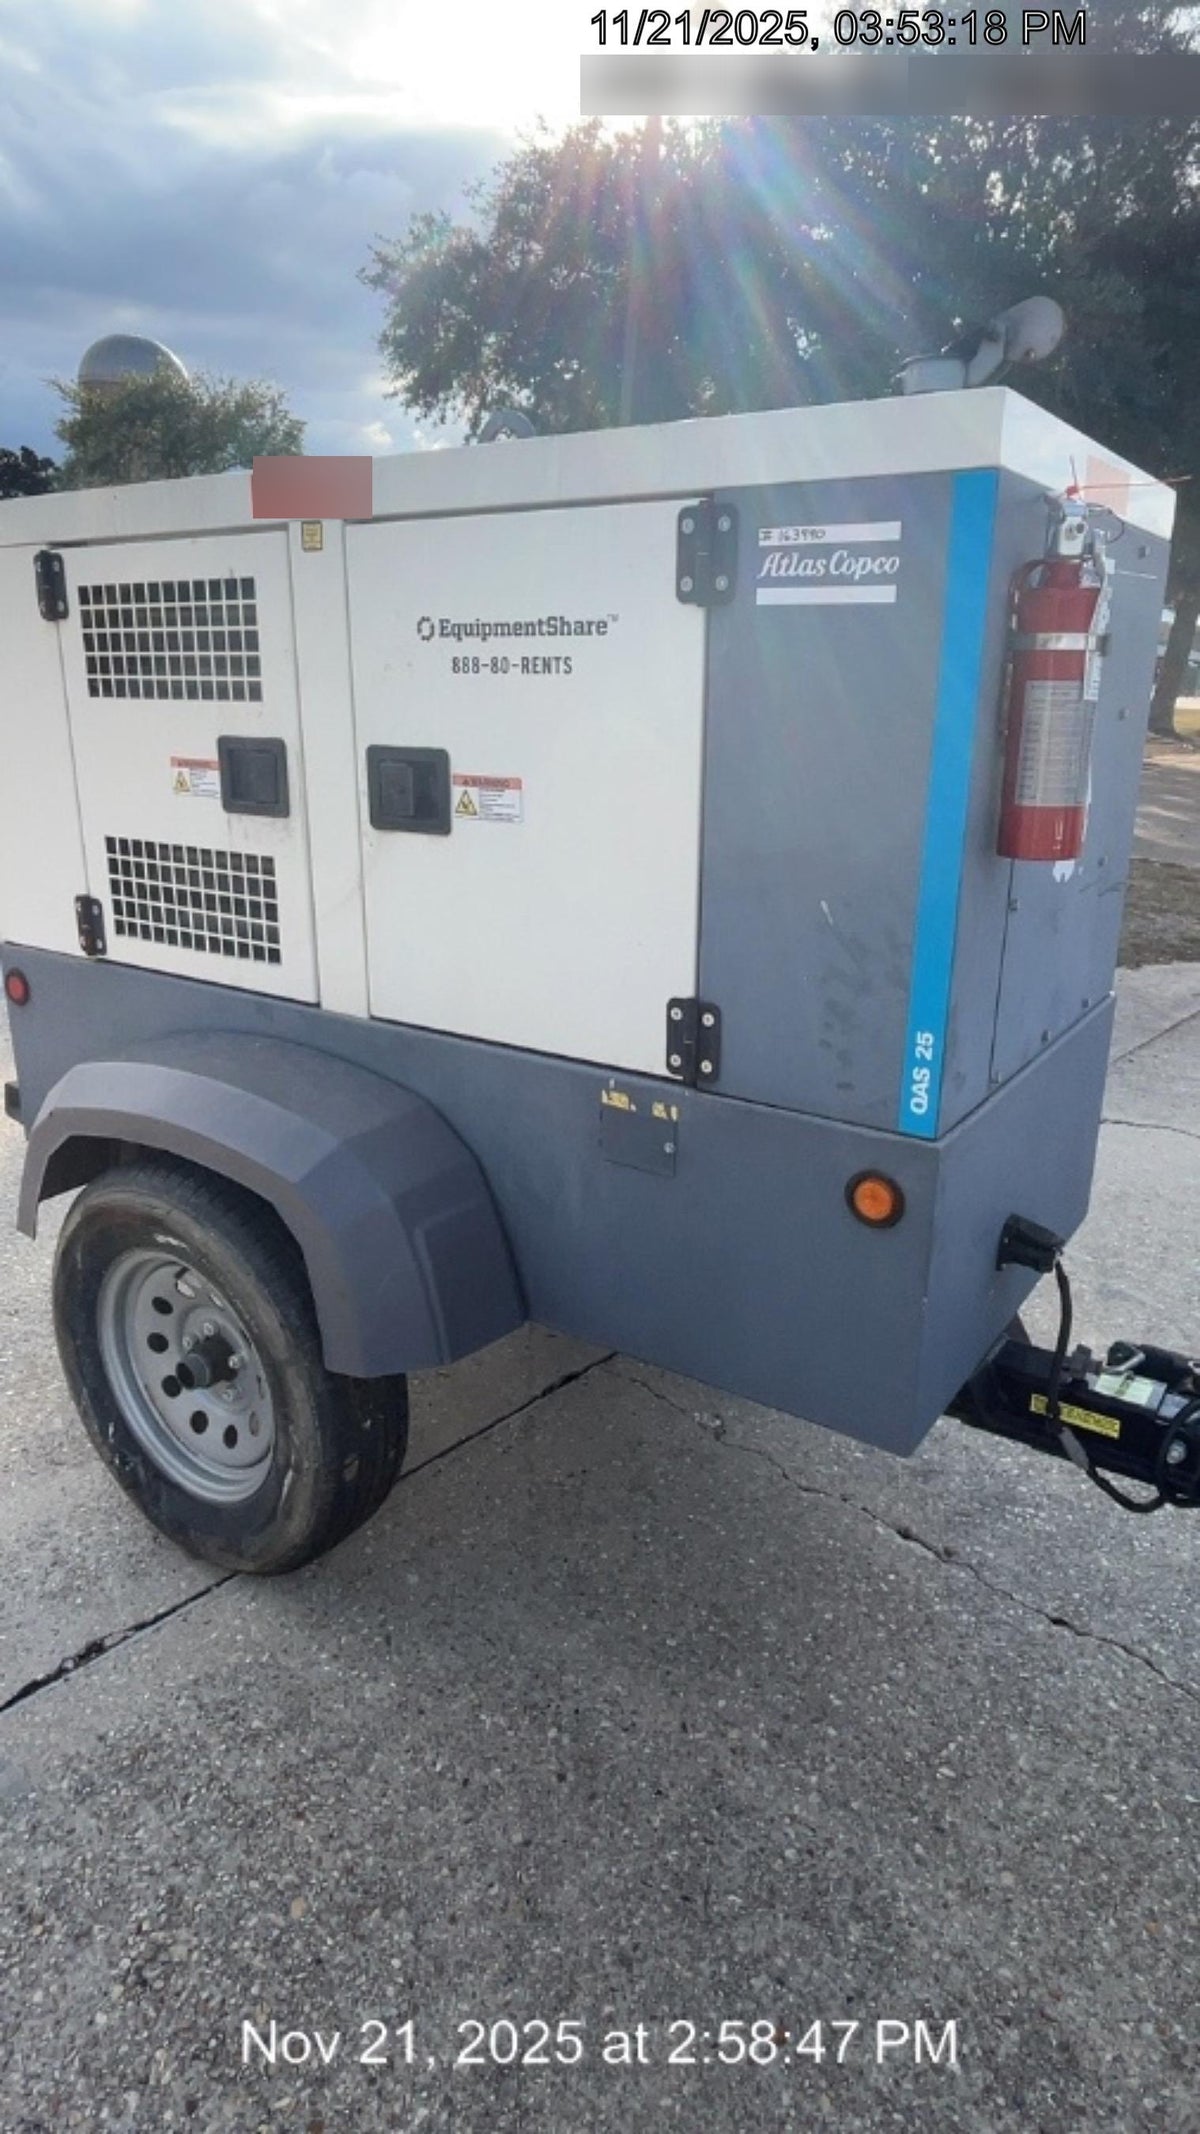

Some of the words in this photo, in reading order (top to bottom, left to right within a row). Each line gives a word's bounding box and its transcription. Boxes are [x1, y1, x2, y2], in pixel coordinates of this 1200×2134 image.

[757, 551, 827, 579] Atlas
[828, 549, 900, 581] Copco
[438, 615, 608, 642] EquipmentShare
[452, 656, 573, 675] 888-80-RENTS
[914, 1030, 933, 1060] 25
